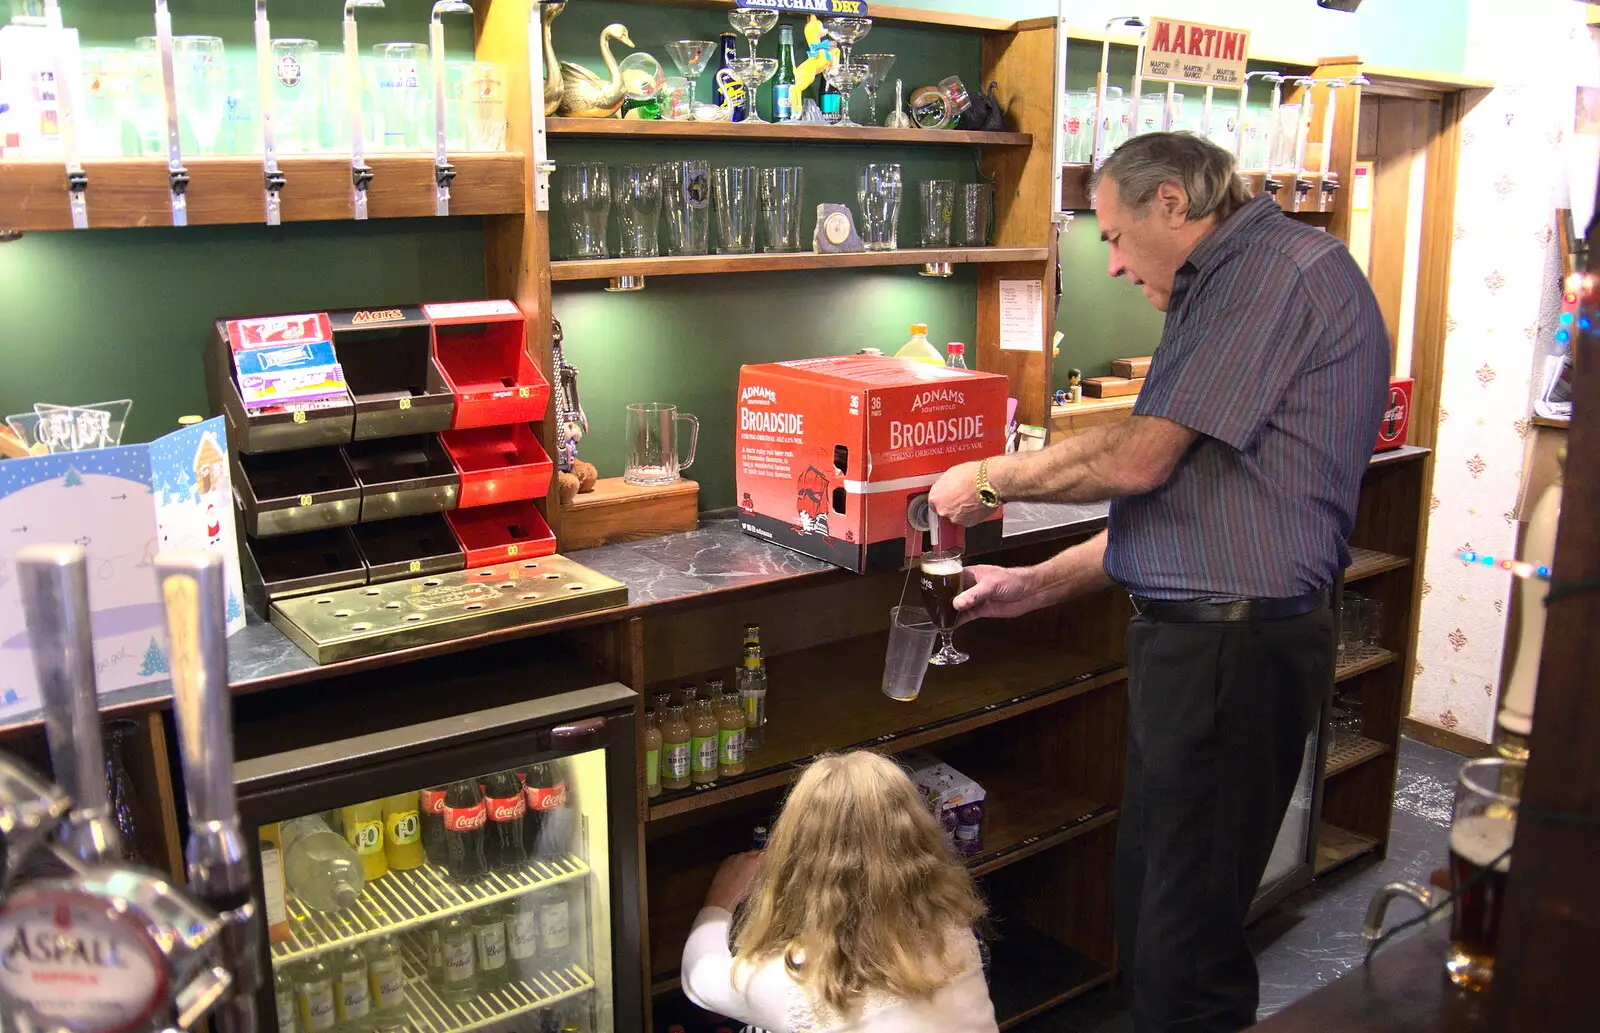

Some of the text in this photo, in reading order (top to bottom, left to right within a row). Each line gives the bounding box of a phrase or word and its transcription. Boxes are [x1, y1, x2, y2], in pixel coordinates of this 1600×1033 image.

[832, 0, 859, 14] DRY
[1152, 22, 1246, 61] MARTINI
[1150, 61, 1171, 69] MARTINI
[1216, 68, 1236, 76] MARTINI
[353, 309, 404, 323] Mars
[850, 394, 859, 408] 36
[872, 397, 881, 410] 36
[921, 404, 956, 414] SOUTHWOLD
[889, 452, 914, 462] STRONG
[915, 448, 944, 458] ORIGINAL
[2, 925, 129, 973] ASPALL
